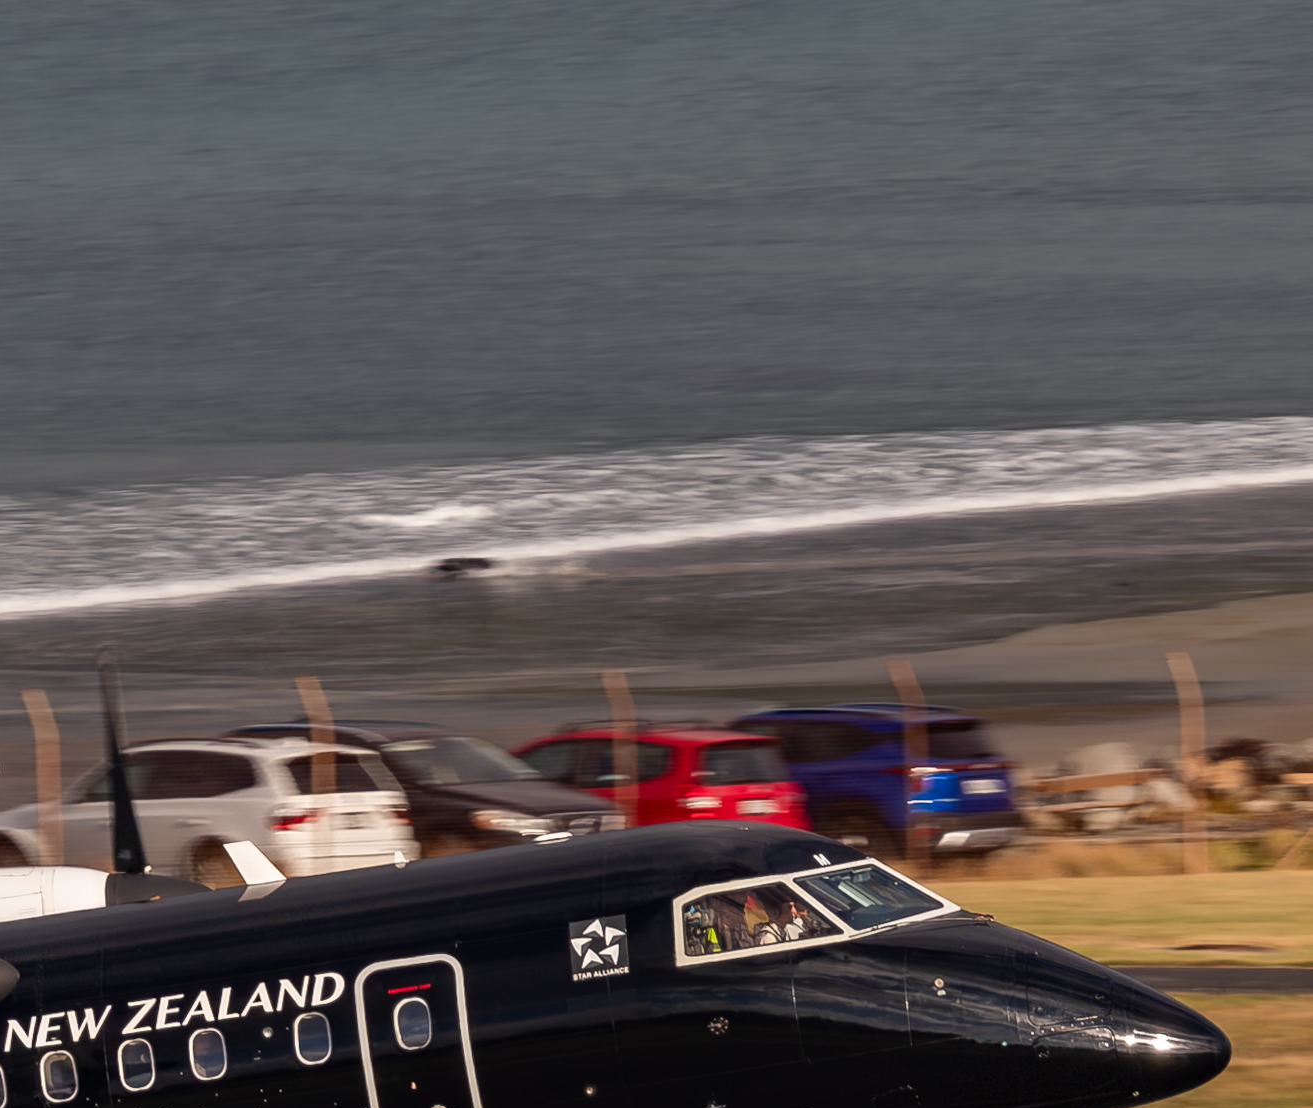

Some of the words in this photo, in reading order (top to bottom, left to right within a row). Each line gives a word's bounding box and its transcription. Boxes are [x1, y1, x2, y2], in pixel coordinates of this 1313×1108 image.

[573, 972, 592, 981] STAR
[593, 966, 629, 977] ALLIANCE
[3, 1004, 112, 1053] NEW
[121, 971, 346, 1035] ZEALAND
